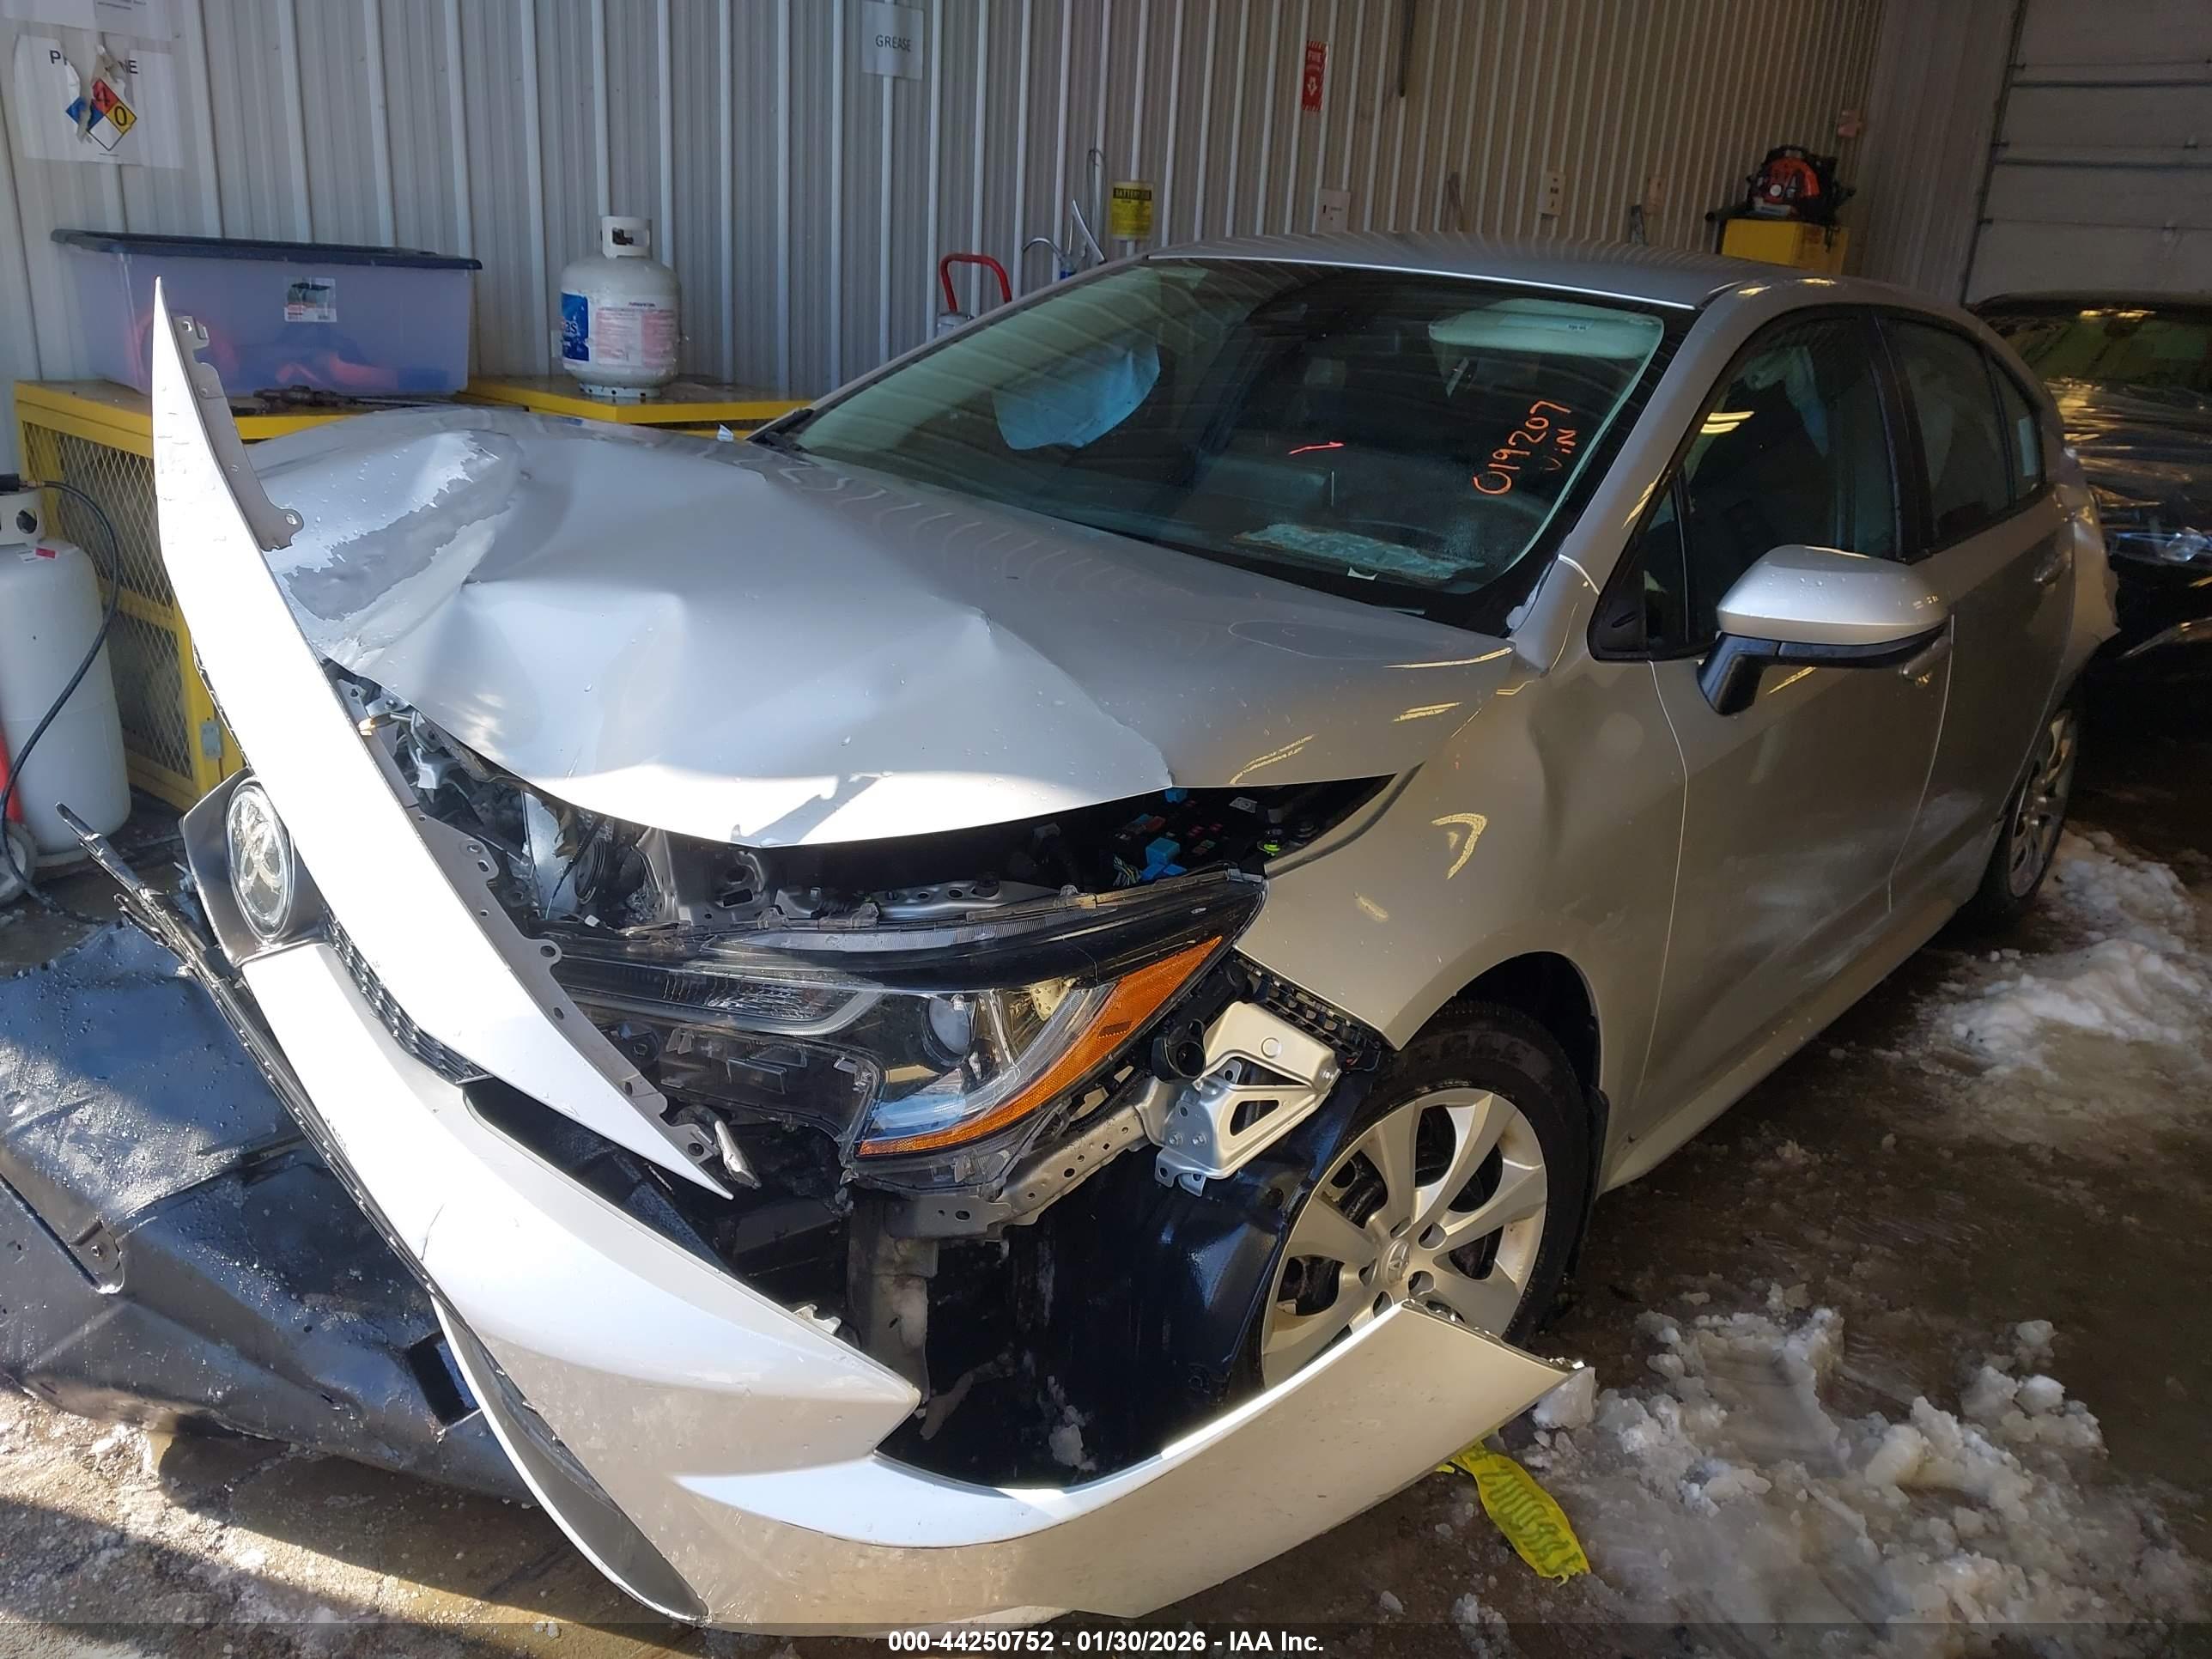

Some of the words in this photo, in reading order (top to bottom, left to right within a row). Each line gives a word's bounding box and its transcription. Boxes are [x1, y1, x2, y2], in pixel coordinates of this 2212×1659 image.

[876, 34, 911, 52] GREASE
[114, 106, 127, 126] 0
[1473, 400, 1571, 495] 019207
